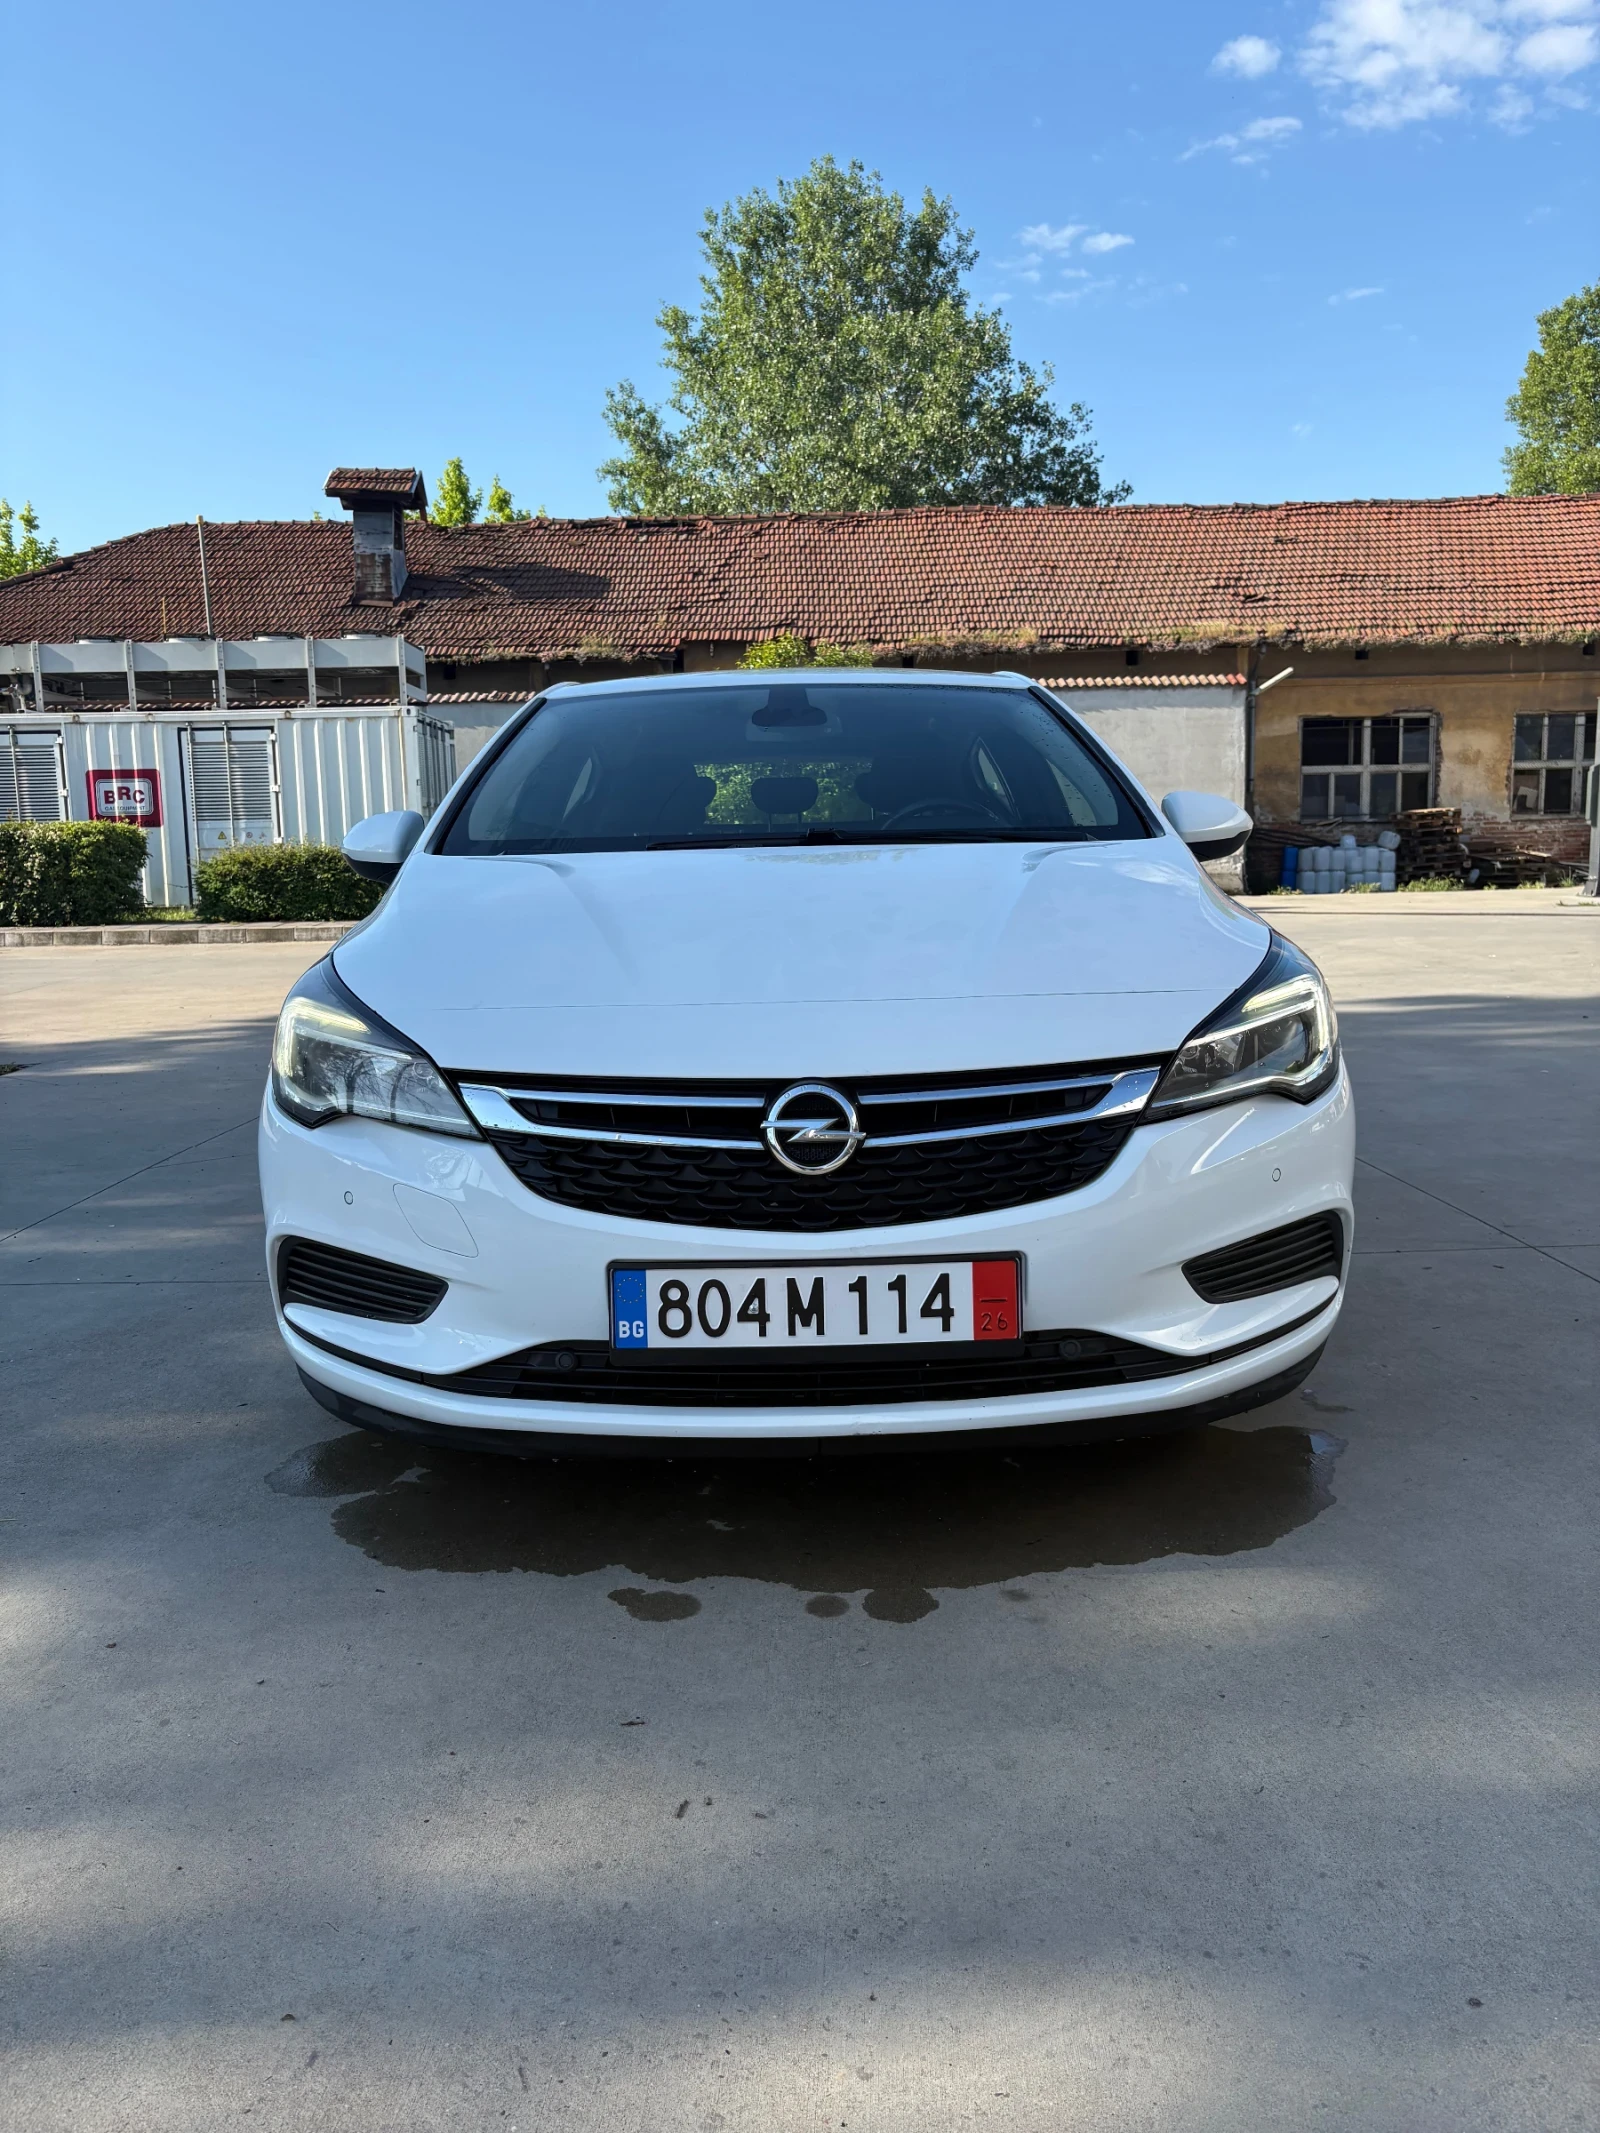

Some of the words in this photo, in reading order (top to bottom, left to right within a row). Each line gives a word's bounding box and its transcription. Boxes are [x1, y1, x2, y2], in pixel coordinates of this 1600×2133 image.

[104, 786, 145, 804] BRC
[658, 1278, 771, 1338] 804
[786, 1277, 825, 1336] M
[848, 1272, 955, 1335] 114
[618, 1320, 645, 1338] BG
[981, 1312, 1008, 1331] 26
